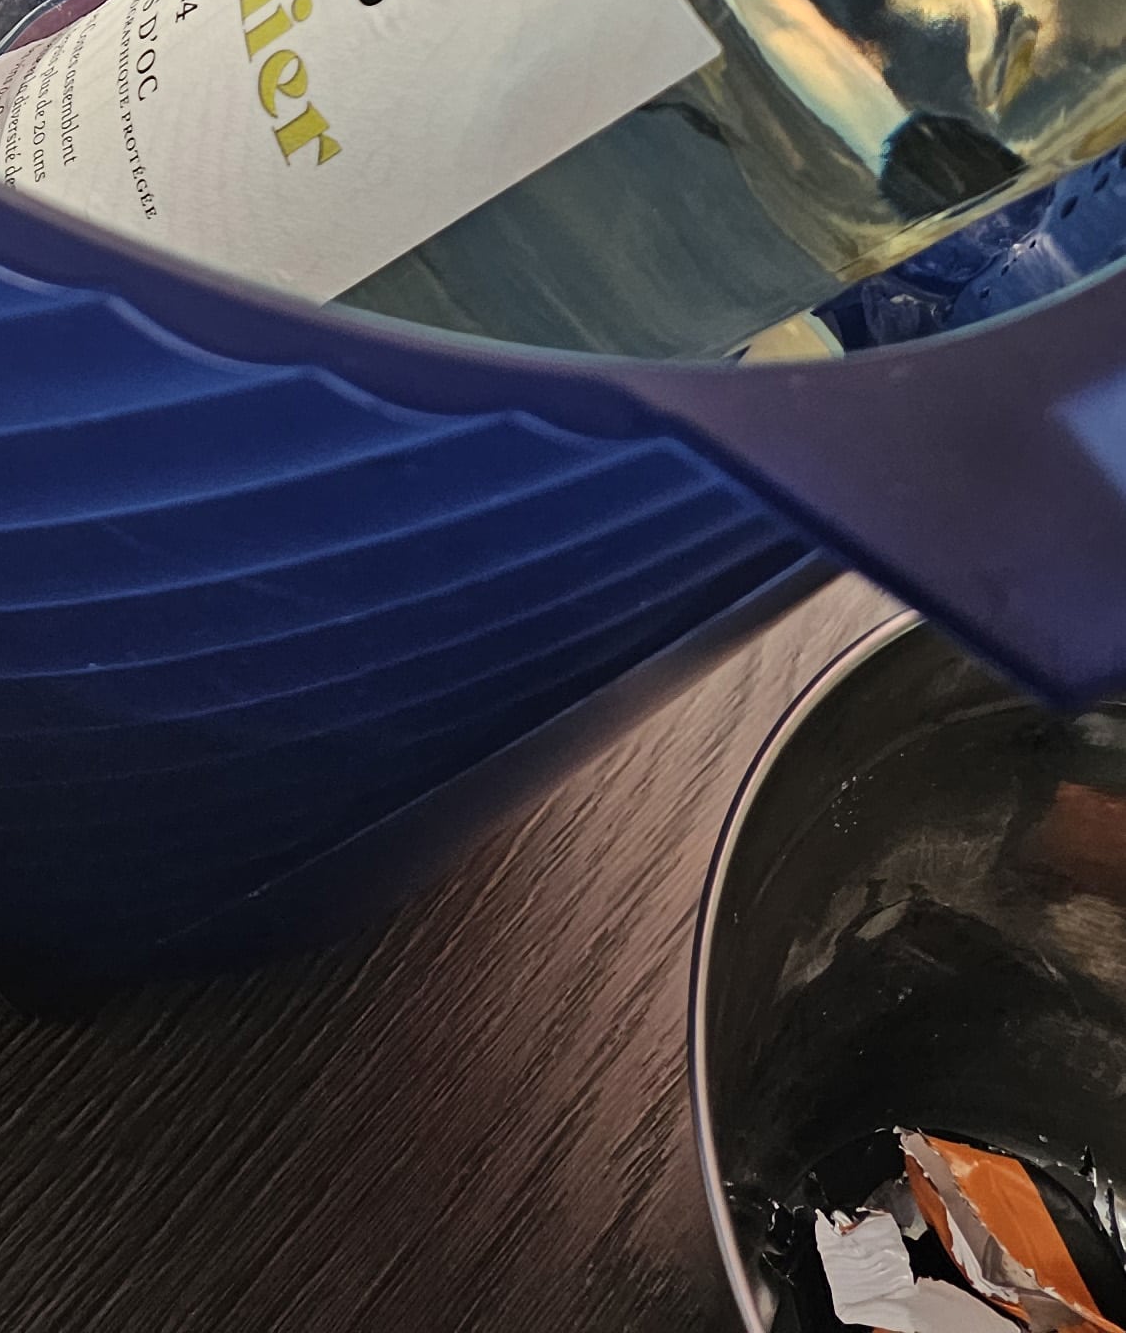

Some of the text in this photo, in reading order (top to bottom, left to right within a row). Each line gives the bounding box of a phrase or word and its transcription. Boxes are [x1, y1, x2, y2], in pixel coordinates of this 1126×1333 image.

[35, 99, 53, 122] de
[61, 69, 80, 167] assemblent
[32, 120, 47, 147] 20
[4, 165, 23, 188] de
[33, 149, 47, 184] ans
[120, 110, 158, 221] PROTÉGÉE
